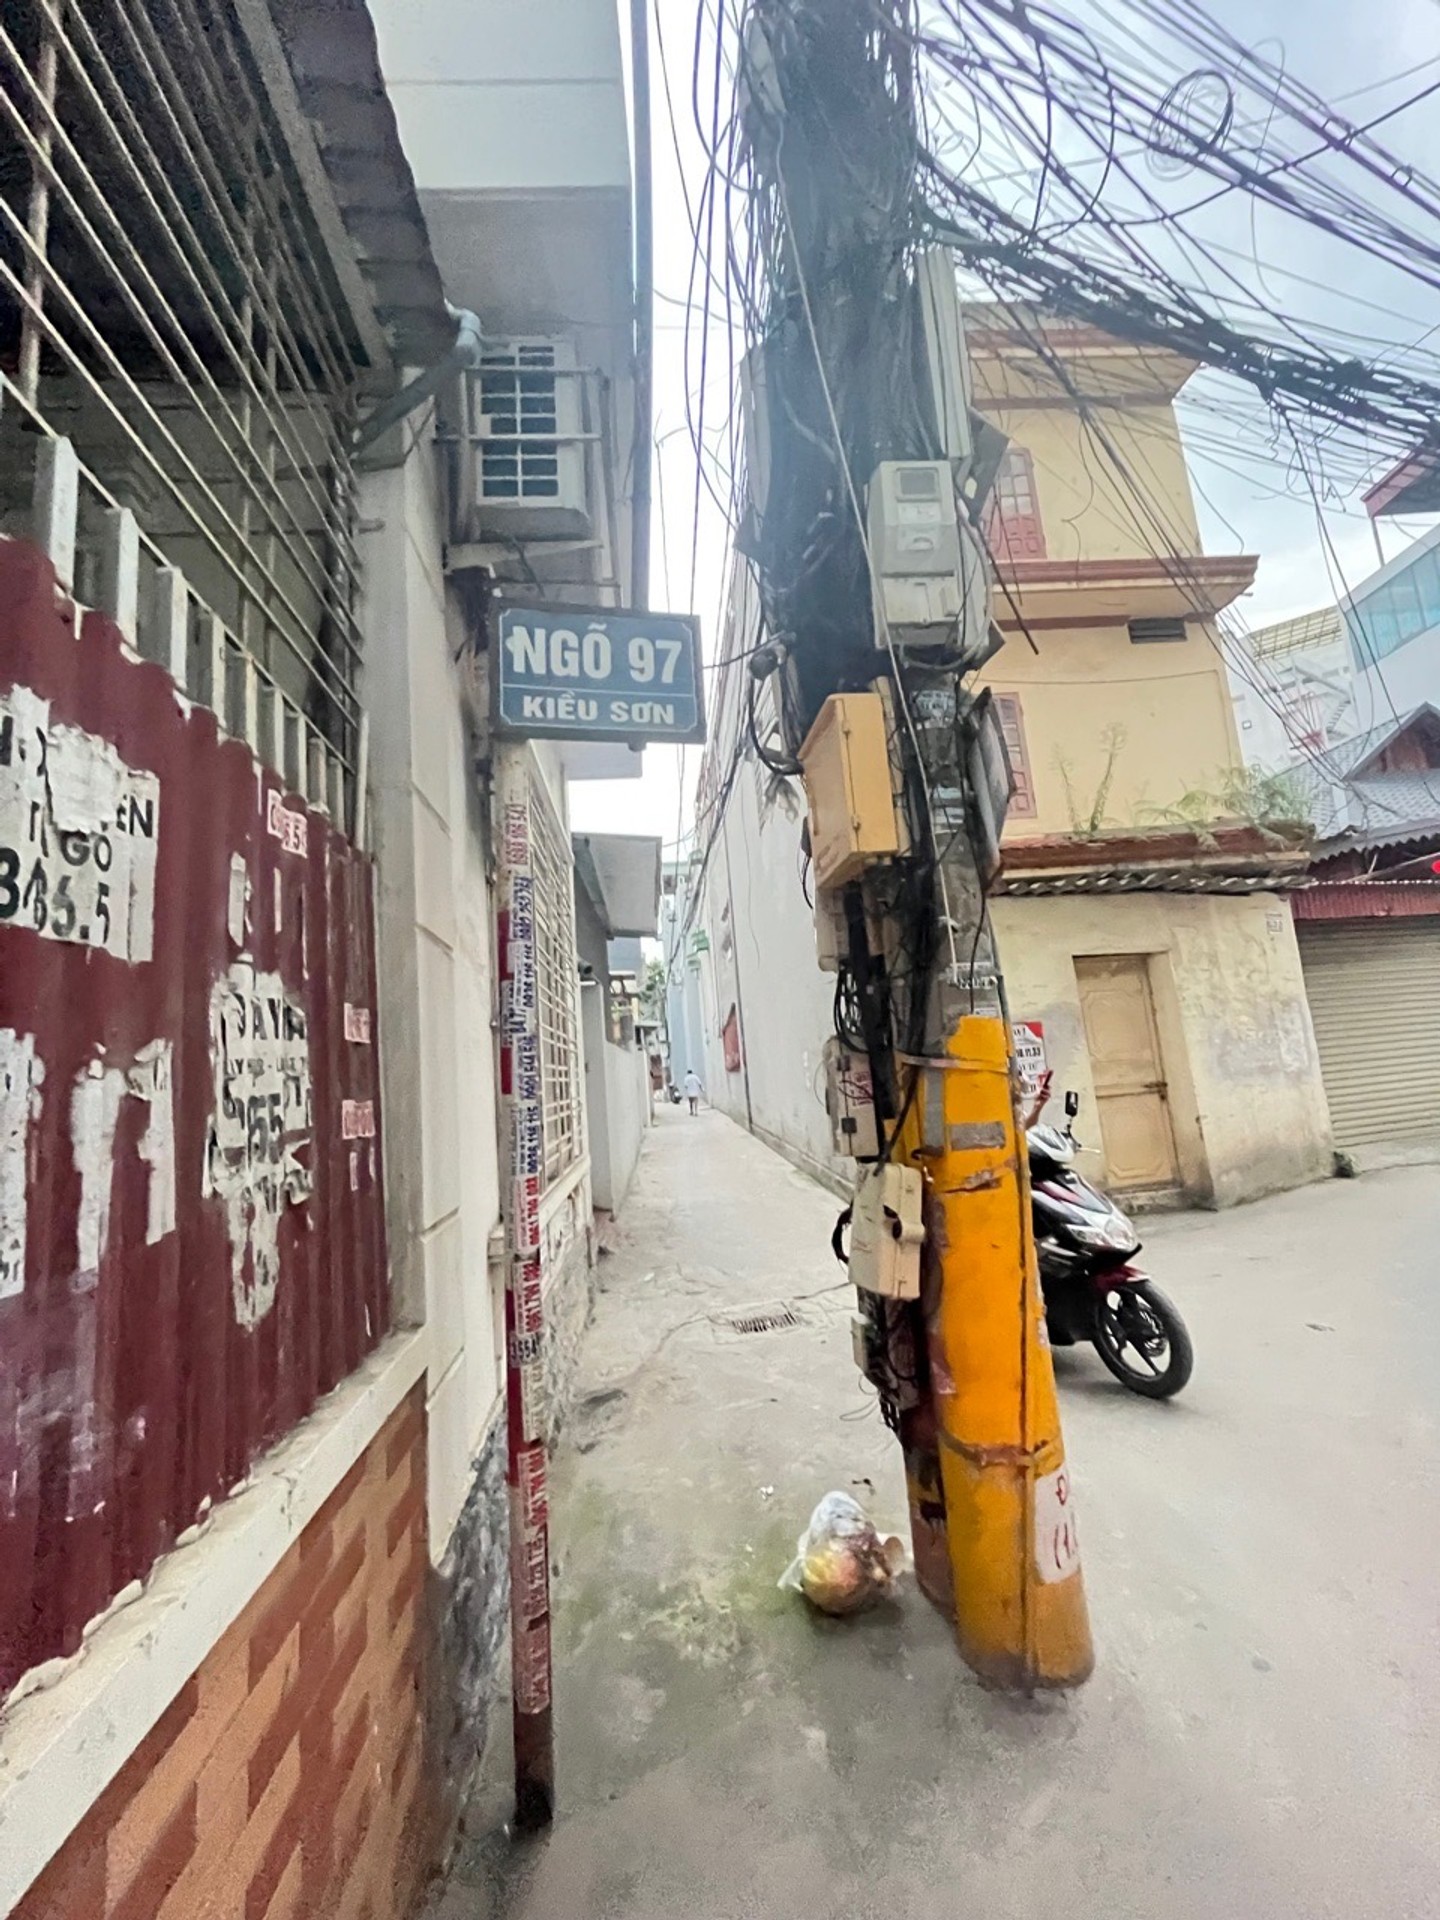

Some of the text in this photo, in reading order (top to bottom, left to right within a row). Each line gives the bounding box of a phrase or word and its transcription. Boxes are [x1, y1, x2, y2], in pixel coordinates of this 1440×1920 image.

[505, 622, 682, 684] NGÕ 97
[523, 690, 674, 725] KIỀU SƠN
